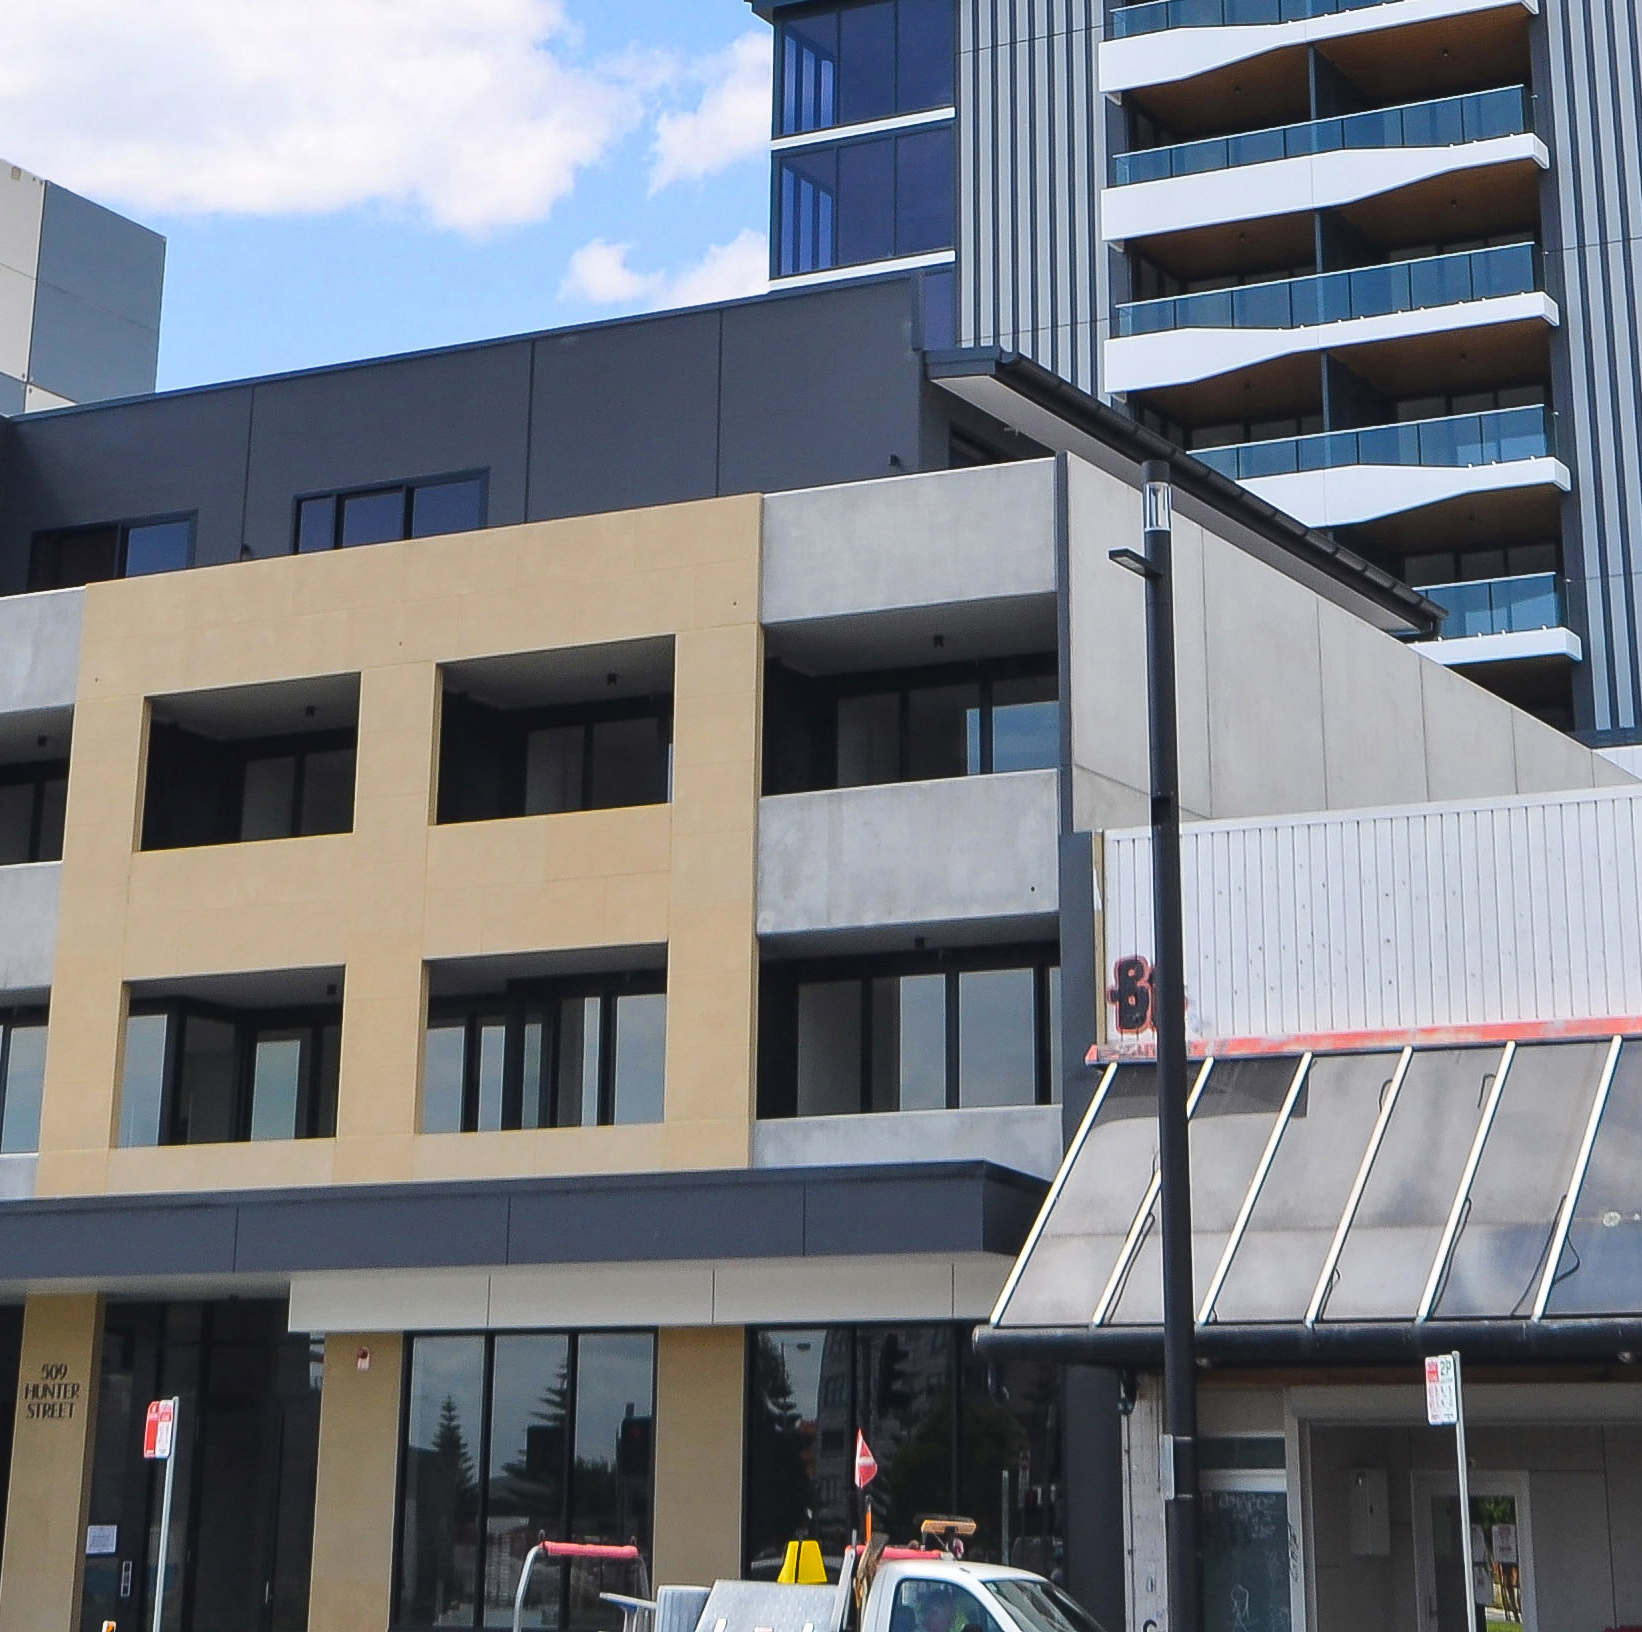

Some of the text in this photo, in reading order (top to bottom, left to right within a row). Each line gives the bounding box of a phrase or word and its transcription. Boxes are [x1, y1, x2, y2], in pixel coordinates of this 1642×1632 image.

[41, 1362, 68, 1379] 509
[24, 1382, 80, 1400] HUNTER
[26, 1402, 75, 1419] STREET
